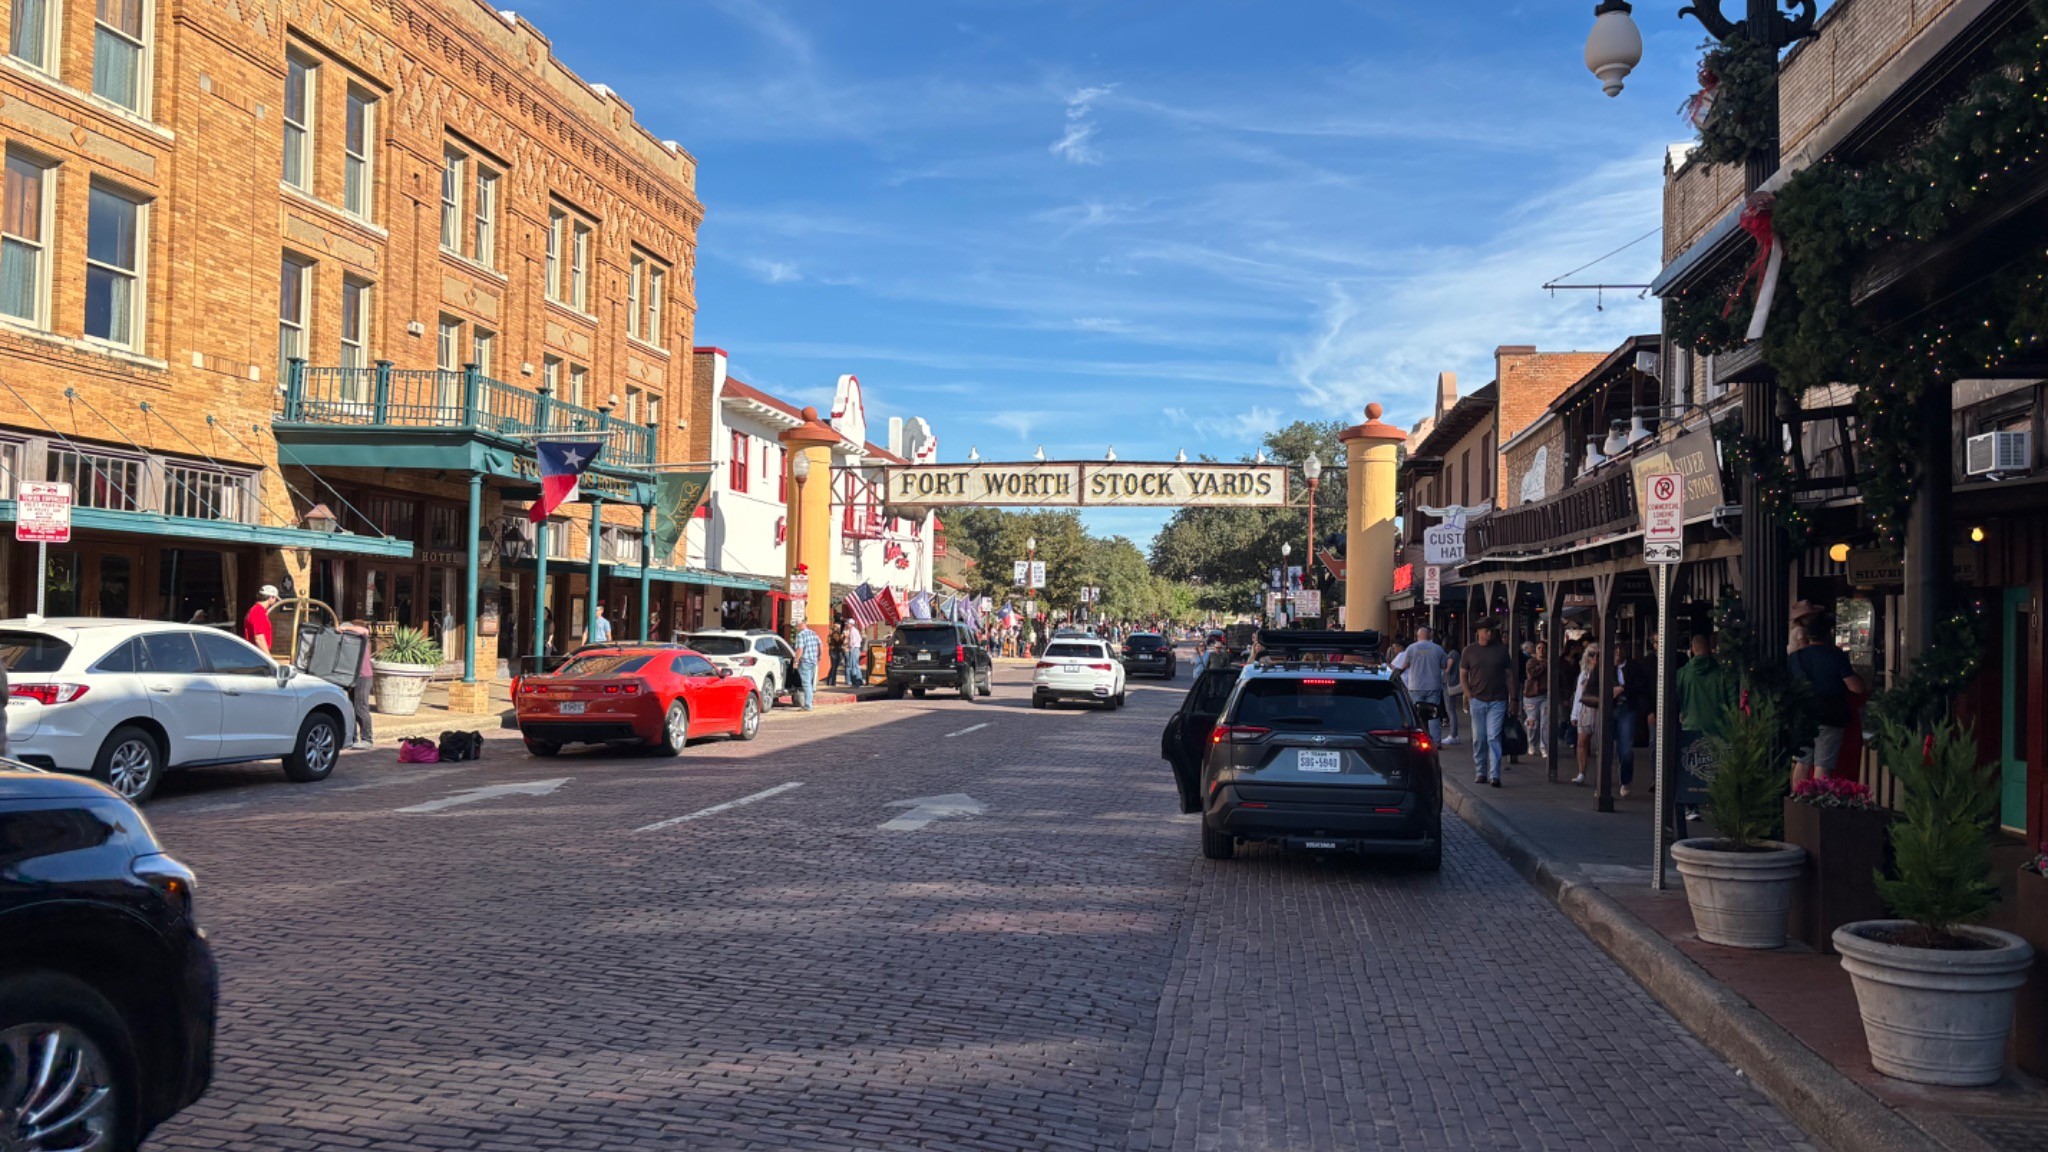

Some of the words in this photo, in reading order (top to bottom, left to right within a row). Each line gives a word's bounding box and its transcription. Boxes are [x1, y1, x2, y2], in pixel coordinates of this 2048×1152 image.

[1675, 451, 1706, 477] SILVER
[900, 472, 970, 497] FORT
[982, 472, 1071, 498] WORTH
[1091, 472, 1175, 498] STOCK
[1186, 472, 1272, 498] YARDS
[1687, 474, 1718, 500] STONE
[1653, 510, 1675, 518] LOADING
[1656, 518, 1671, 526] ZONE
[421, 551, 460, 563] HOTEL
